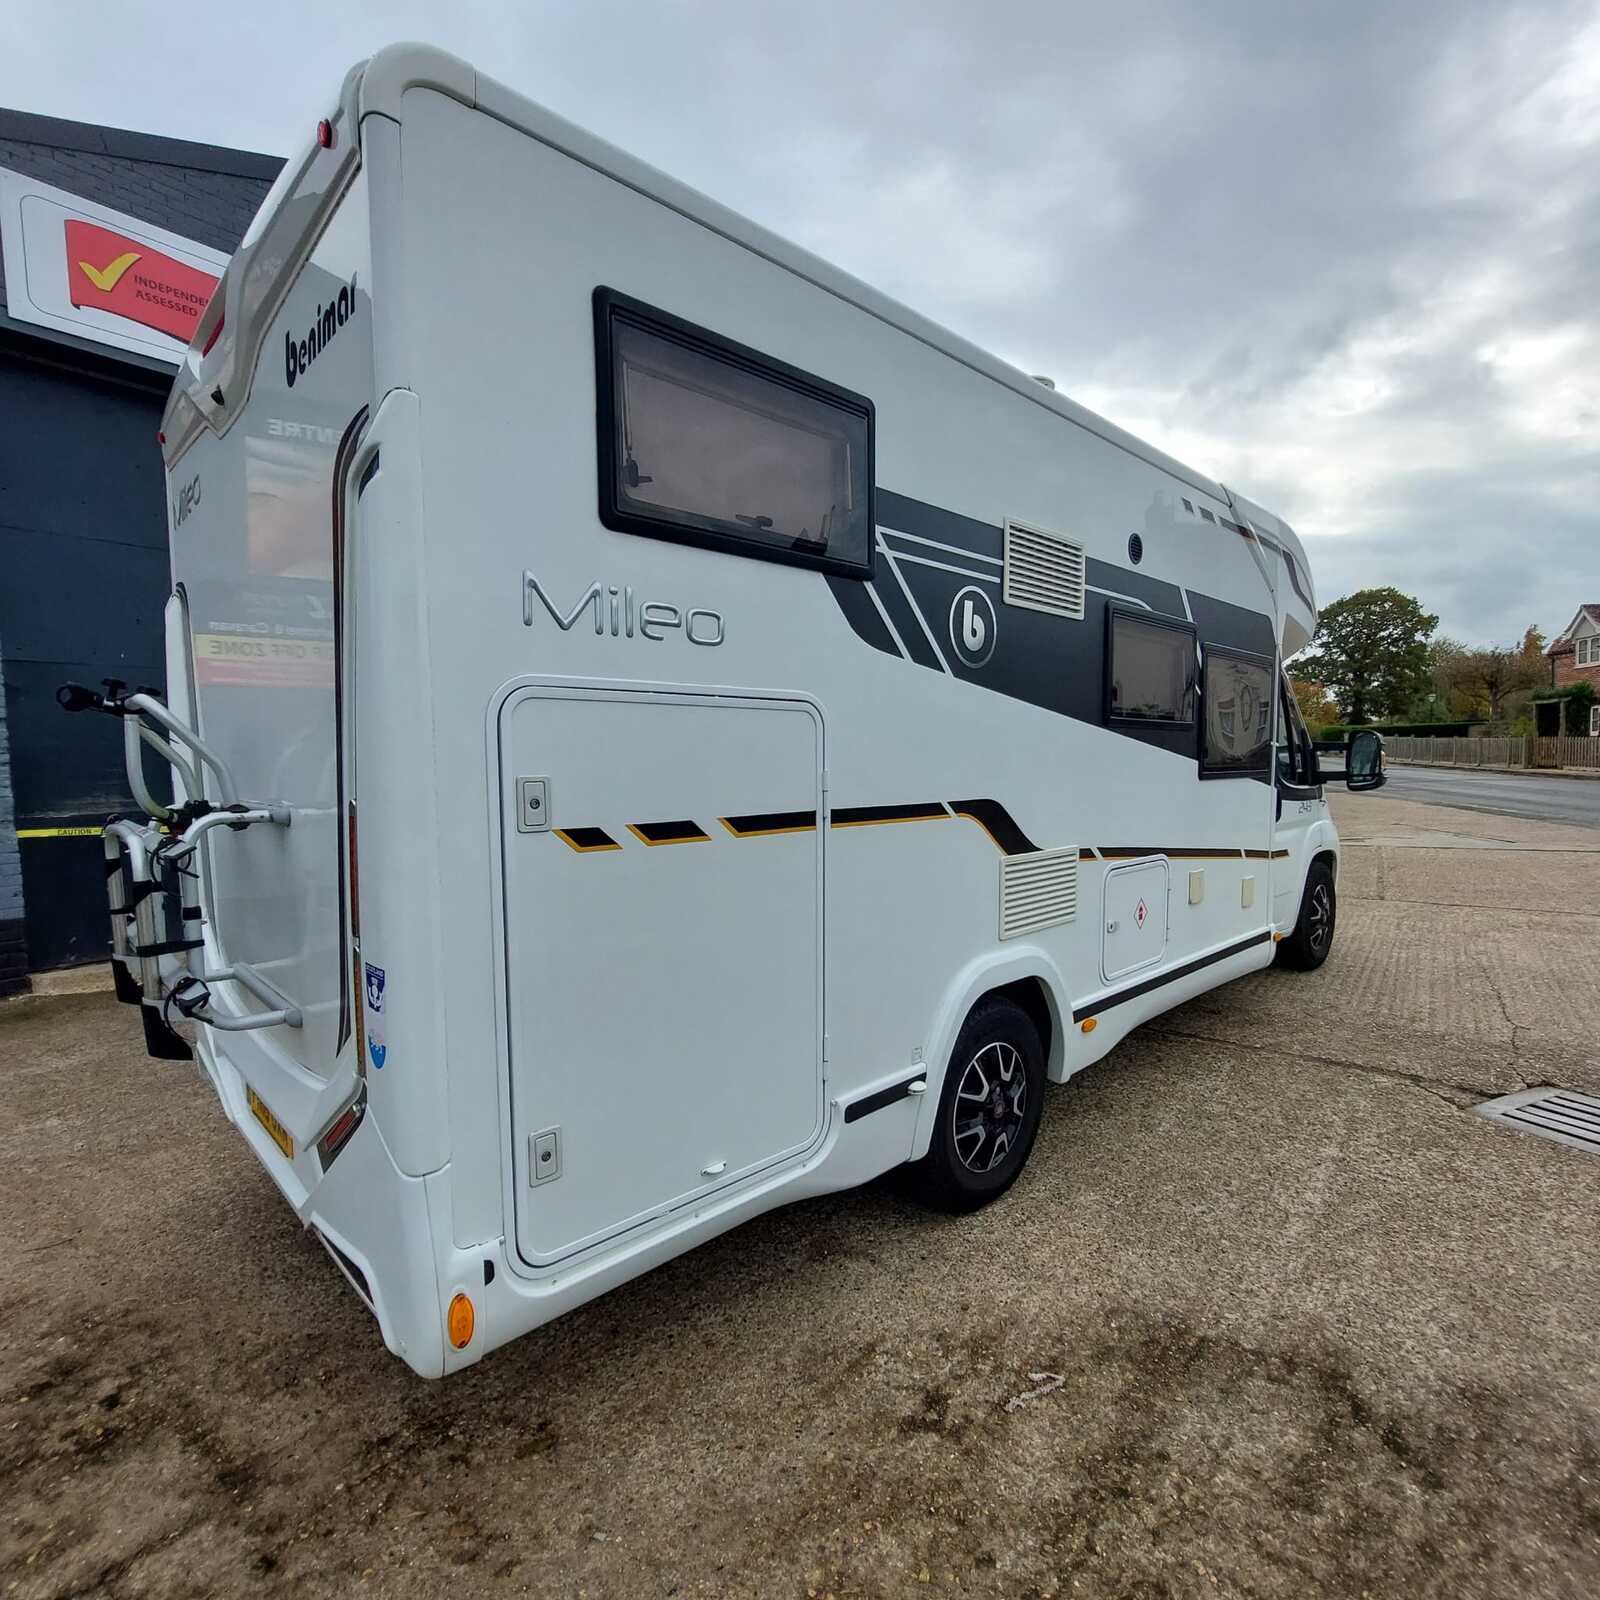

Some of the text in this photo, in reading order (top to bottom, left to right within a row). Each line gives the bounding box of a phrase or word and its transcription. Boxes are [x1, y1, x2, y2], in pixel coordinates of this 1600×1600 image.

[134, 274, 209, 308] INDEPENDE
[135, 290, 199, 317] ASSESSED
[285, 270, 357, 388] benimar
[522, 569, 726, 647] Mileo
[57, 828, 92, 837] CAUTION
